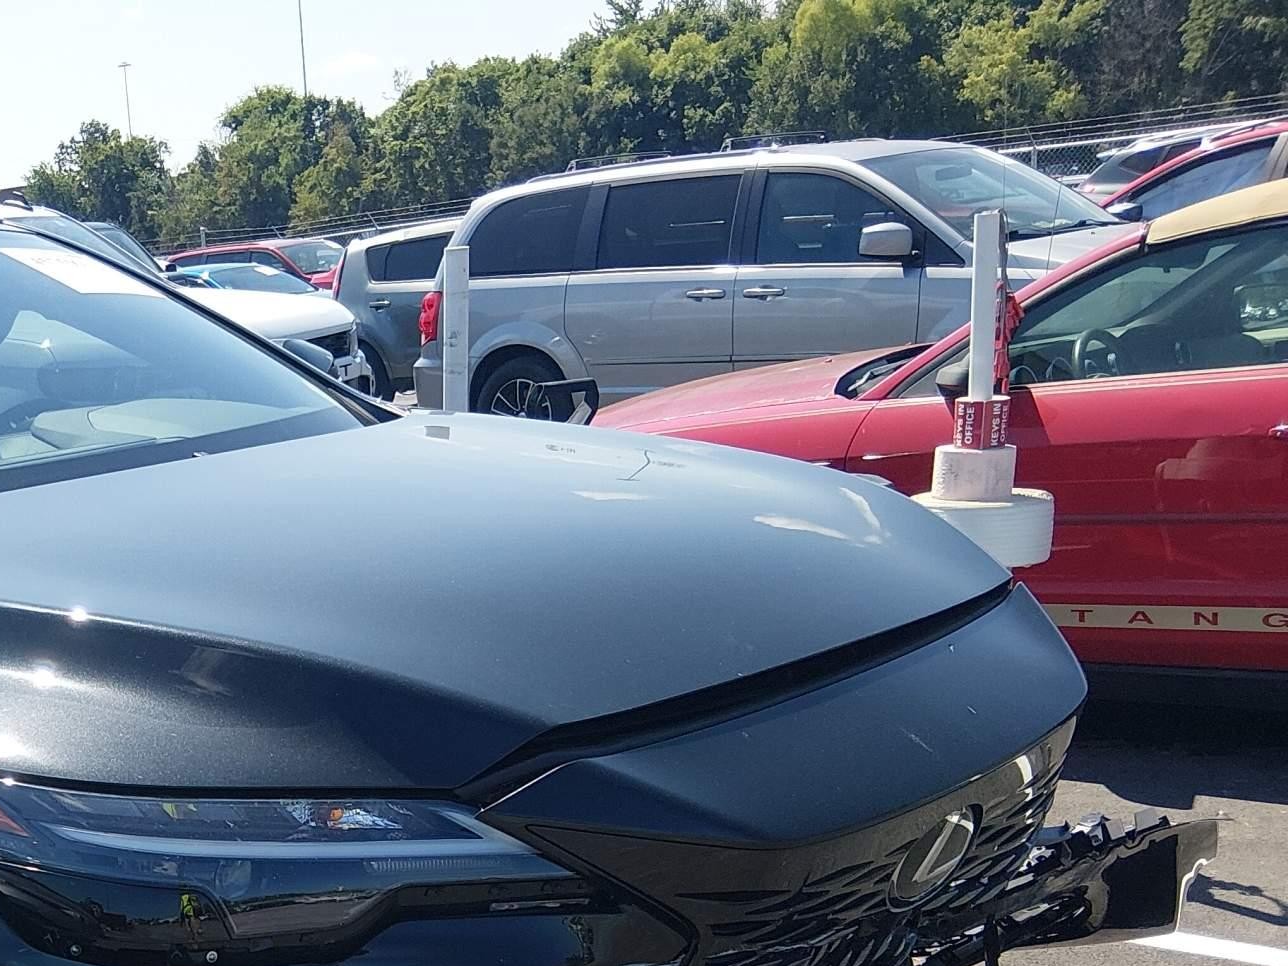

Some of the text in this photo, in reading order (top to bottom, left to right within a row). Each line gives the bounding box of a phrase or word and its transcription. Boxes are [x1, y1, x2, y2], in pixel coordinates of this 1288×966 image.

[954, 403, 965, 447] KEYS IN
[964, 406, 975, 445] OFFICE
[990, 403, 1001, 446] KEYS IN
[999, 404, 1009, 442] OFFICE
